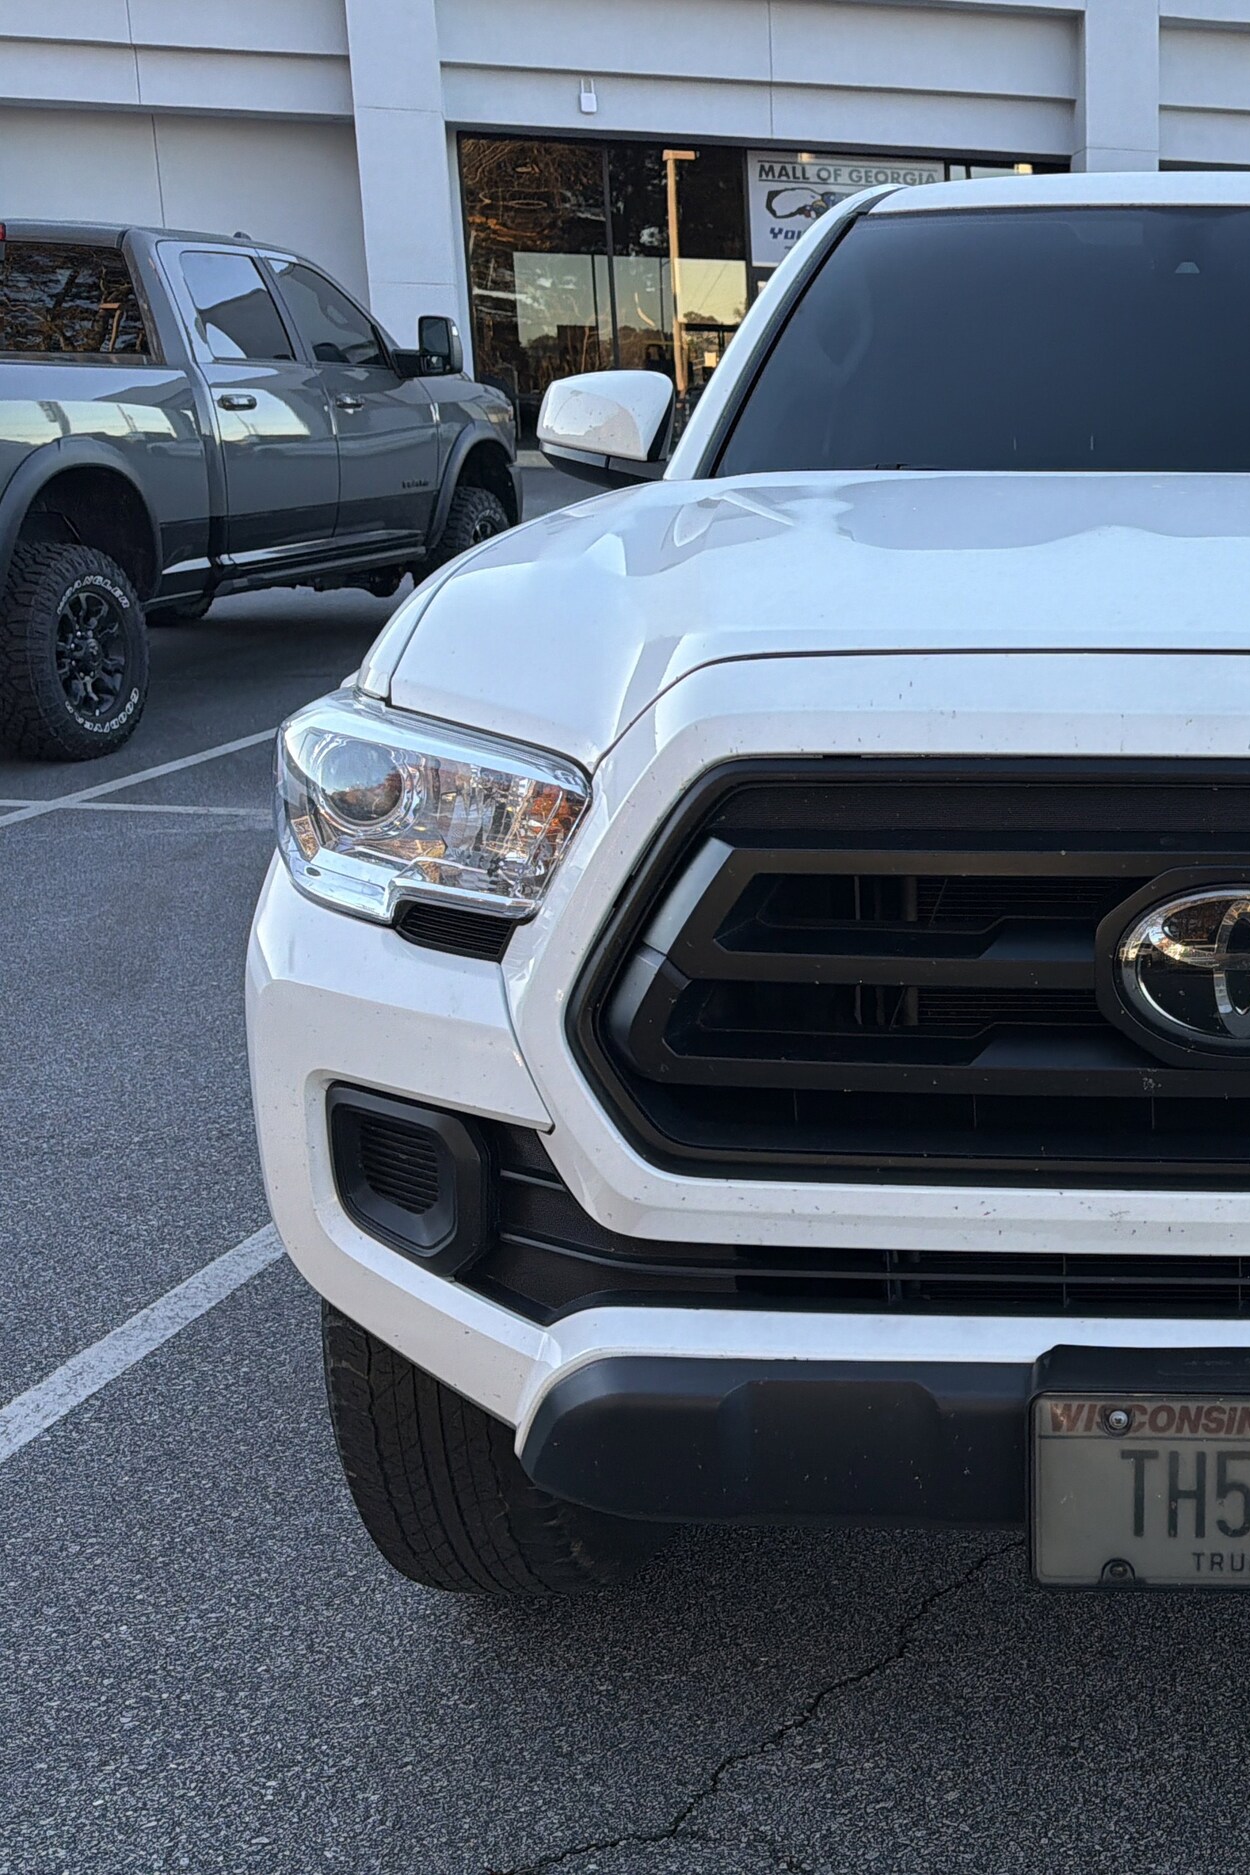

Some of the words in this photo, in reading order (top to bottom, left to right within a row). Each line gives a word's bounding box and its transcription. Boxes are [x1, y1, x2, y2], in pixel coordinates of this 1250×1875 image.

[758, 164, 810, 181] MALL
[816, 167, 842, 182] OF
[848, 168, 937, 184] GEORGIA
